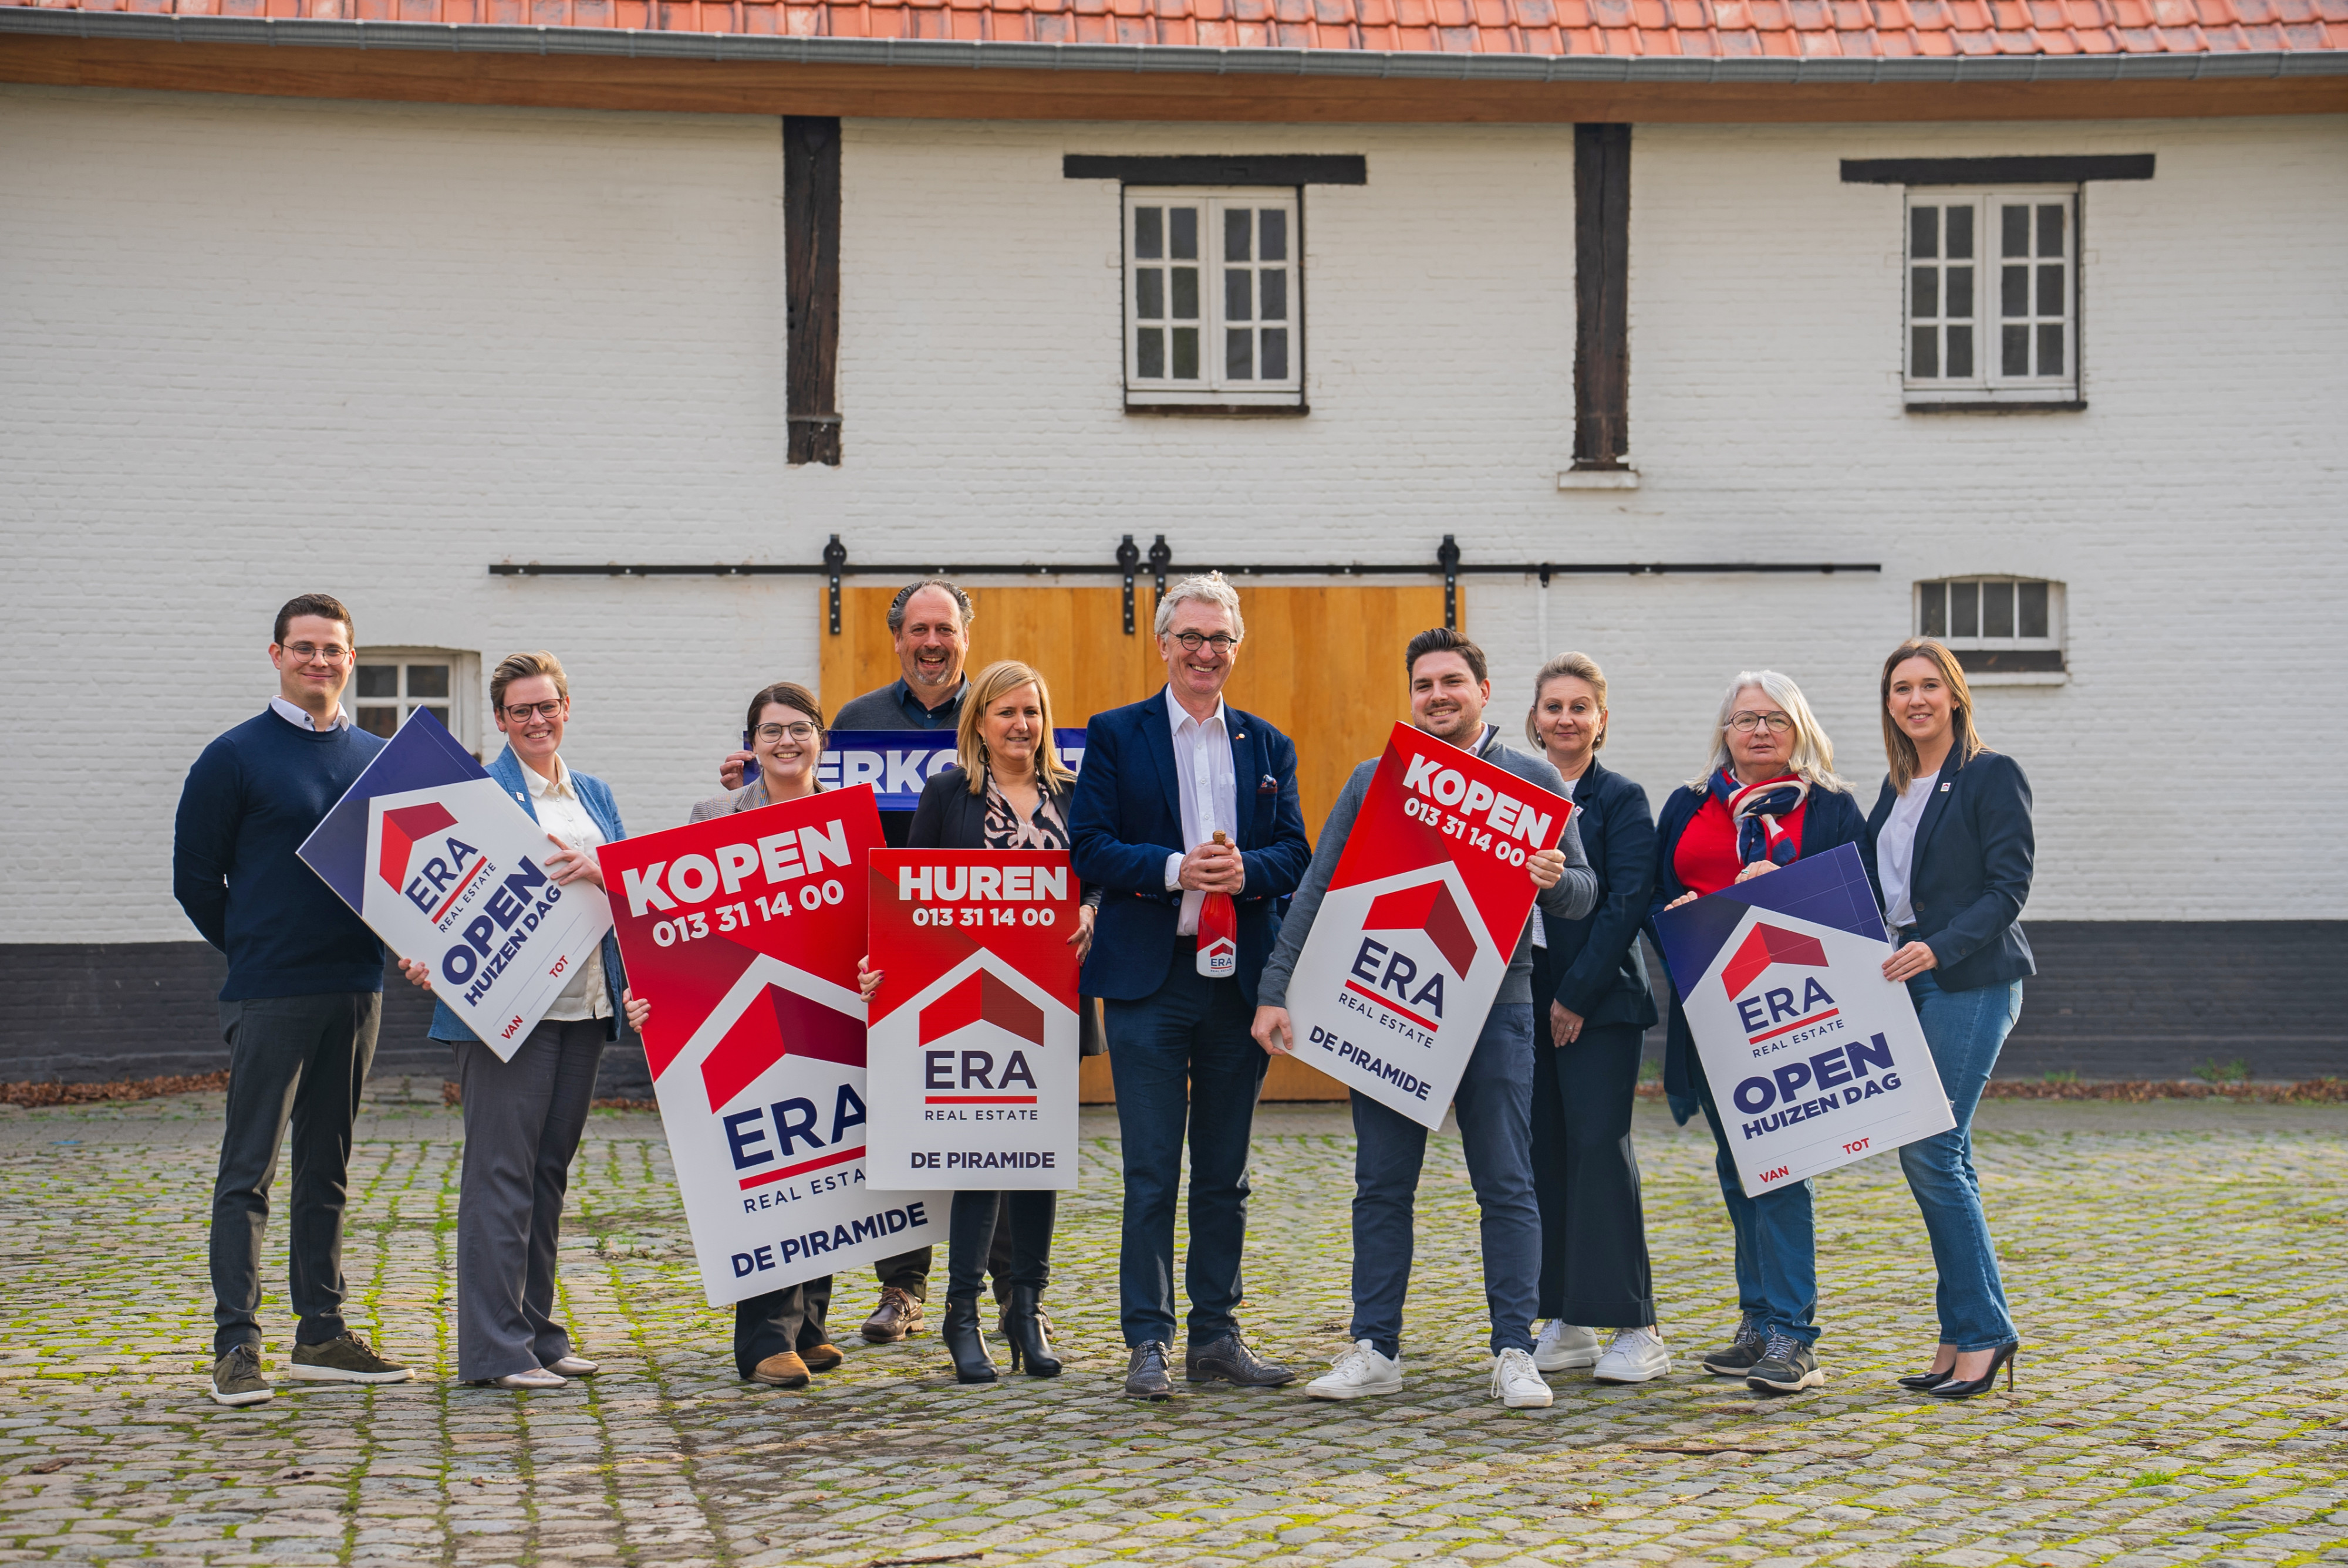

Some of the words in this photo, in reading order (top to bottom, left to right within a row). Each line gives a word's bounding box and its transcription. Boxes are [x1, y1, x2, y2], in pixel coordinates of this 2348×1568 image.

[1402, 752, 1553, 850] KOPEN
[1404, 797, 1442, 826] 013
[1442, 815, 1467, 840] 31
[1469, 827, 1492, 852] 14
[1495, 841, 1525, 867] 00
[404, 837, 479, 915] ERA
[438, 905, 464, 933] REAL
[463, 862, 496, 904] ESTATE
[621, 819, 852, 918] KOPEN
[899, 866, 1067, 901] HUREN
[442, 855, 548, 985] OPEN
[653, 911, 709, 947] 013
[715, 901, 750, 932] 31
[754, 891, 792, 922] 14
[799, 879, 844, 911] 00
[912, 908, 953, 926] 013
[960, 908, 983, 926] 31
[990, 908, 1016, 926] 14
[1022, 908, 1055, 926] 00
[464, 927, 528, 1008] HUIZEN
[522, 884, 562, 933] DAG
[549, 955, 569, 978] TOT
[1211, 958, 1232, 966] ERA
[1351, 937, 1443, 1019] ERA
[1736, 976, 1835, 1033] ERA
[501, 1015, 524, 1040] VAN
[1338, 992, 1374, 1019] REAL
[1379, 1013, 1434, 1049] ESTATE
[1752, 1040, 1788, 1058] REAL
[1792, 1019, 1845, 1044] ESTATE
[925, 1050, 1038, 1089] ERA
[1308, 1025, 1338, 1052] DE
[1338, 1040, 1432, 1101] PIRAMIDE
[1733, 1032, 1895, 1114] OPEN
[723, 1083, 866, 1170] ERA
[925, 1110, 967, 1120] REAL
[976, 1110, 1038, 1120] ESTATE
[1742, 1093, 1840, 1140] HUIZEN
[1843, 1073, 1902, 1105] DAG
[911, 1152, 941, 1168] DE
[947, 1152, 1055, 1168] PIRAMIDE
[1759, 1165, 1789, 1183] VAN
[1843, 1137, 1870, 1154] TOT
[744, 1187, 802, 1214] REAL
[811, 1168, 866, 1195] ESTA
[731, 1245, 776, 1278] DE
[780, 1201, 929, 1264] PIRAMIDE
